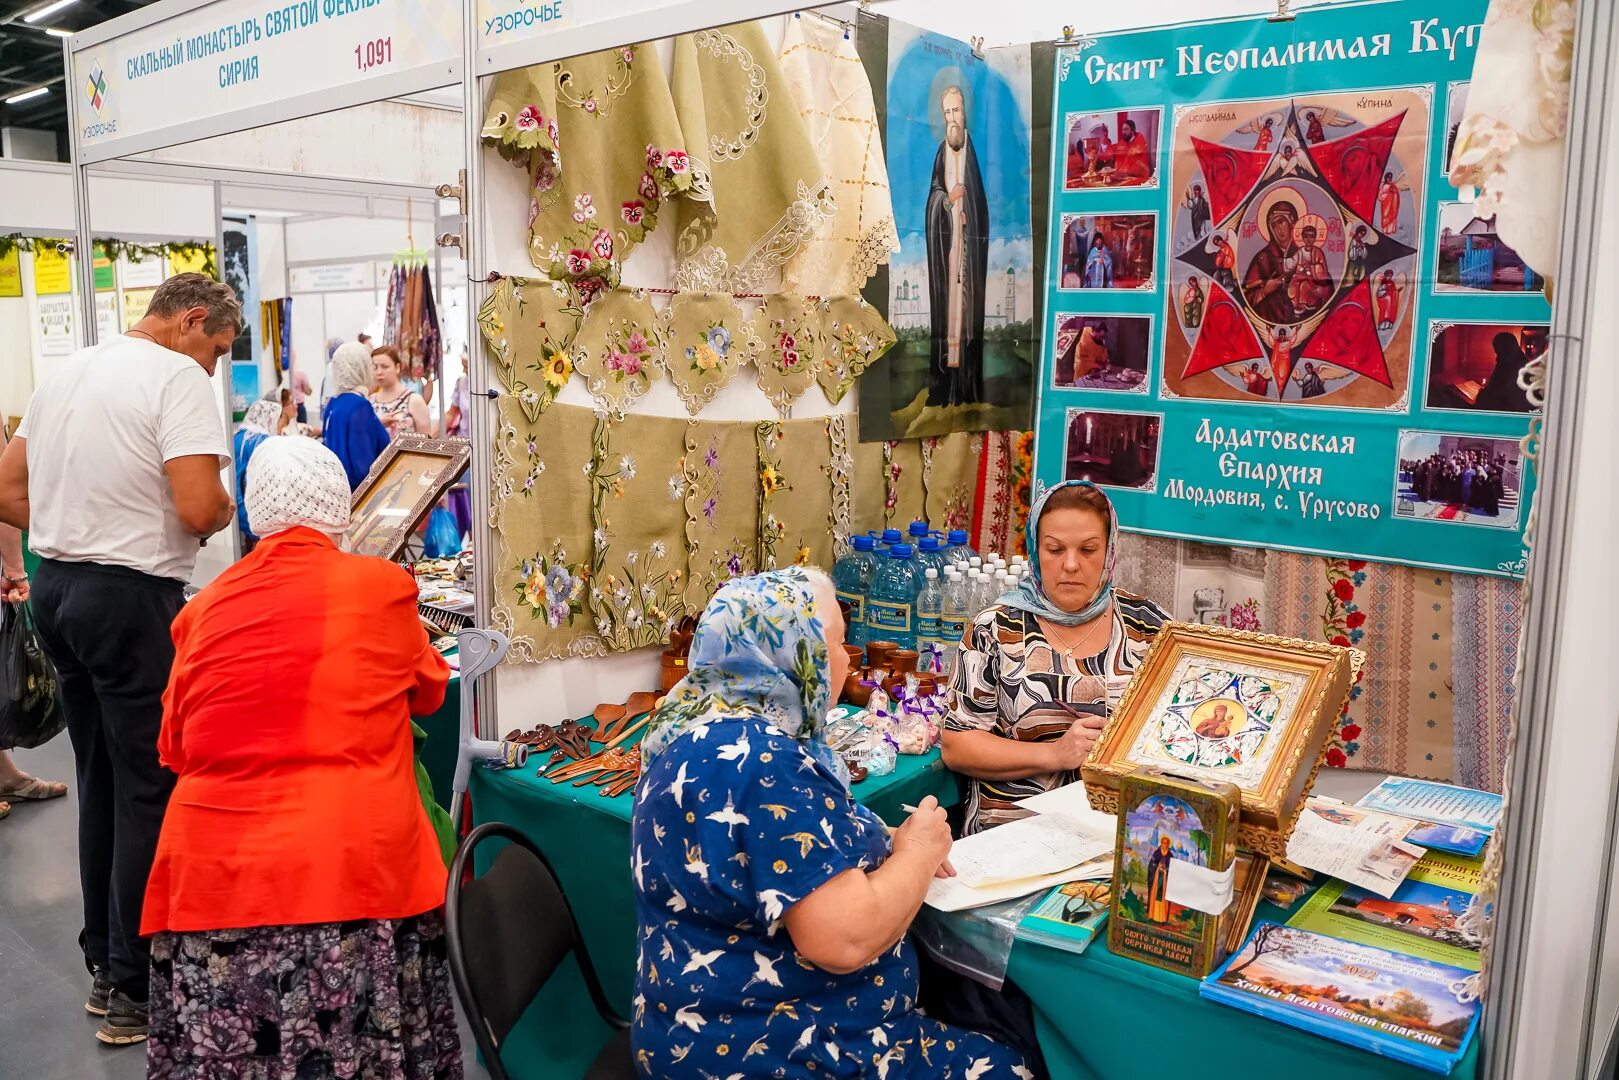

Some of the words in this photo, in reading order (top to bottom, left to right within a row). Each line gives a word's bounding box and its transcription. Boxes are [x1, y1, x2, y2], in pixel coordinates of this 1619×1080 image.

[485, 1, 562, 36] УЗОРОЧЬЕ
[127, 38, 184, 80] СКАЛЬНЫЙ
[186, 17, 261, 62] МОНАСТЫРЬ
[265, 0, 319, 38] СВЯТОЙ
[354, 36, 392, 72] 1,091
[219, 56, 259, 88] СИРИЯ
[1084, 54, 1164, 85] Скит
[1175, 33, 1391, 77] Неопалимая
[1195, 418, 1356, 454] Ардатовская
[1218, 452, 1323, 490] Епархия
[1163, 478, 1266, 511] Мордовия,
[1274, 494, 1289, 510] с.
[1298, 491, 1381, 522] Урусово
[1434, 869, 1465, 882] 2022
[1339, 963, 1380, 981] 2022
